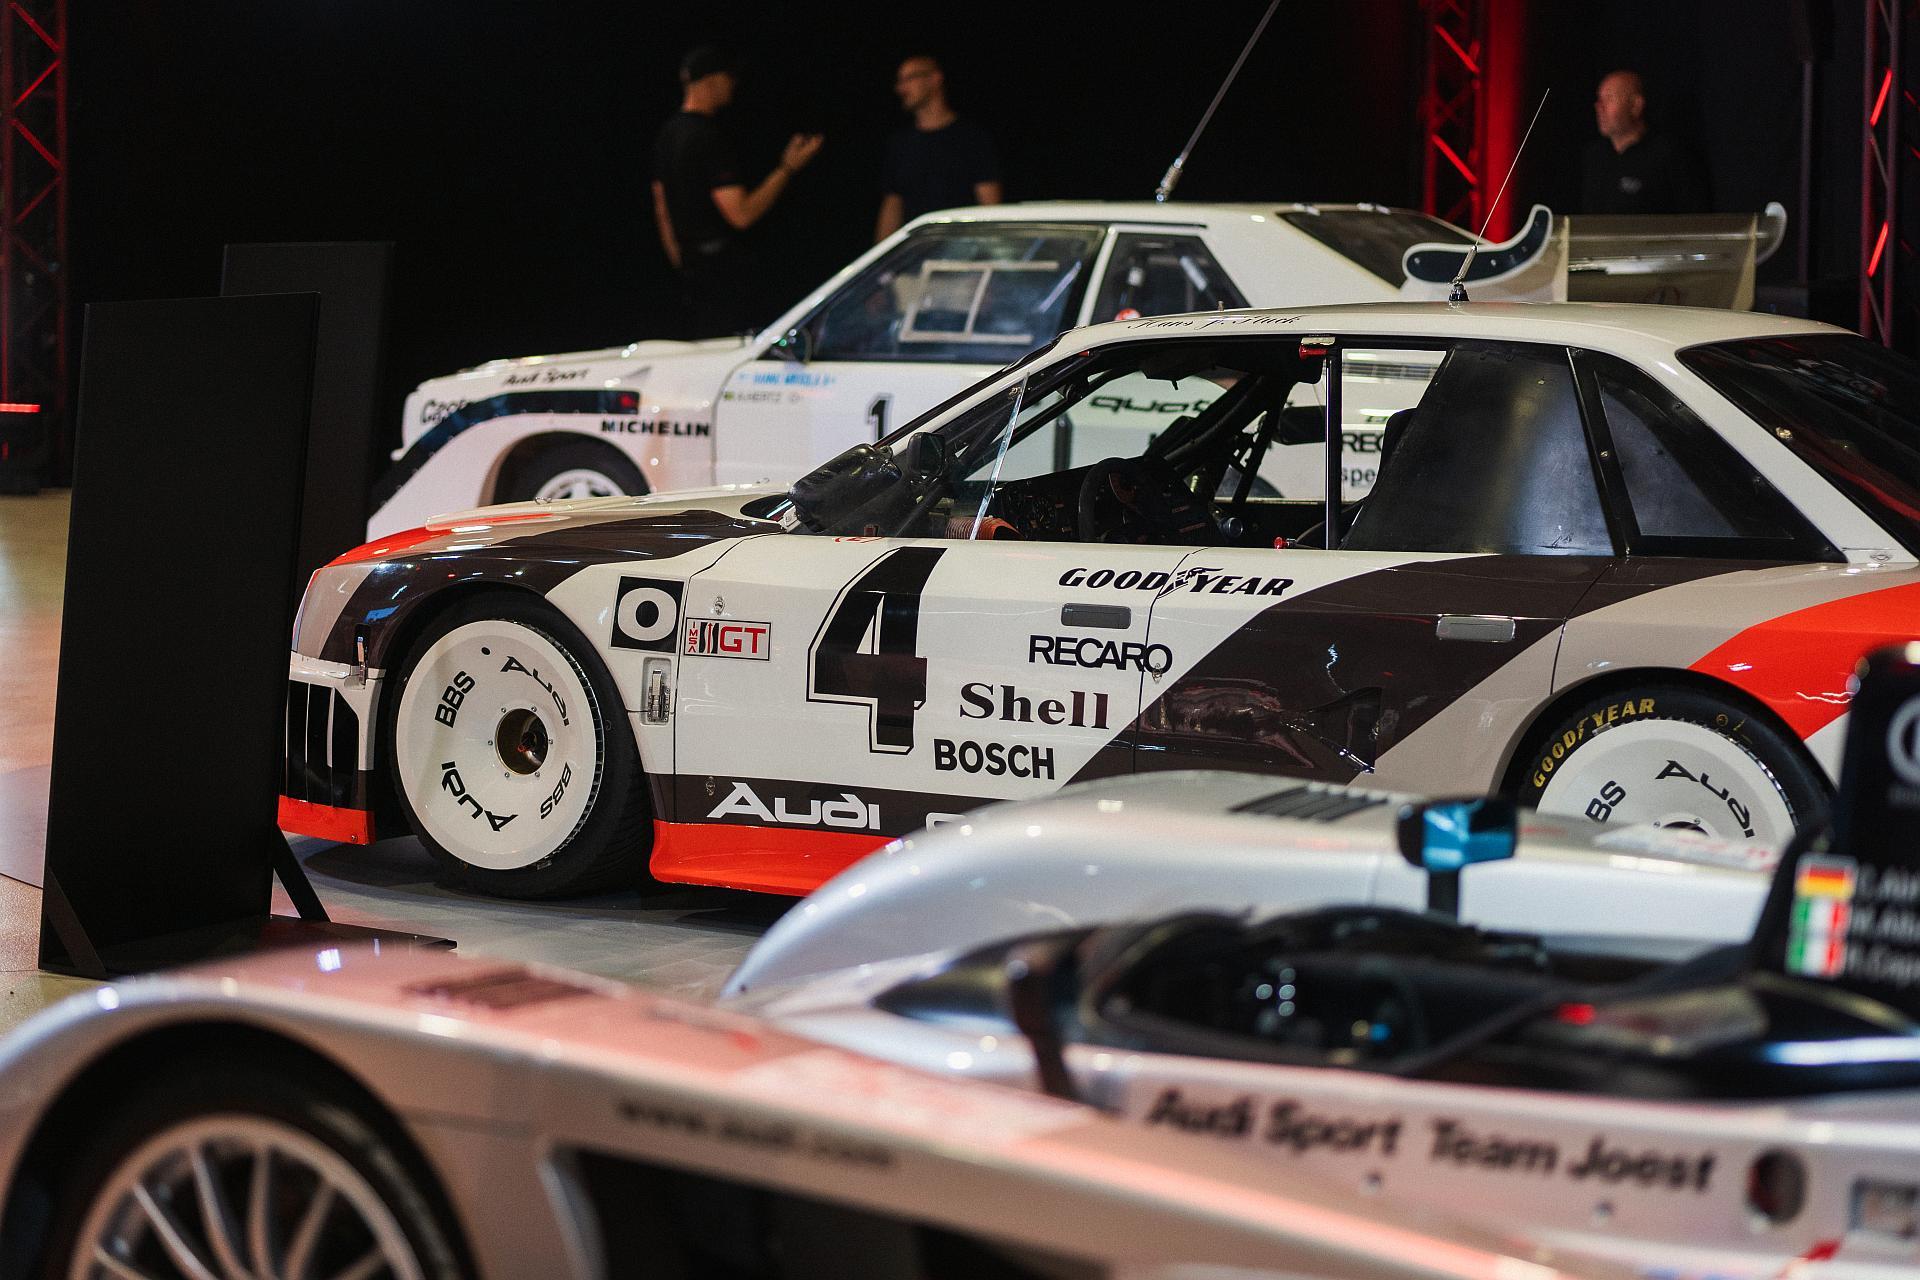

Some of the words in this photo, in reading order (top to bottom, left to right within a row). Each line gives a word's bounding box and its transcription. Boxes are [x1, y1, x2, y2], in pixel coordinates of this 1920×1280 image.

[601, 419, 710, 438] MICHELIN
[719, 625, 767, 654] GT
[807, 546, 948, 755] 4
[1028, 635, 1174, 675] RECARO
[434, 671, 475, 729] BBS
[500, 655, 570, 728] Audi
[959, 682, 1110, 730] Shell
[933, 738, 1055, 780] BOSCH
[440, 760, 520, 832] Audi
[540, 762, 571, 820] BBS
[706, 781, 881, 831] Audi
[1584, 780, 1626, 825] BS
[1655, 759, 1756, 838] Audi
[1145, 1088, 1256, 1138] Audi
[1264, 1099, 1402, 1156] Sport
[1428, 1117, 1560, 1174] Team
[1567, 1134, 1716, 1192] Joest
